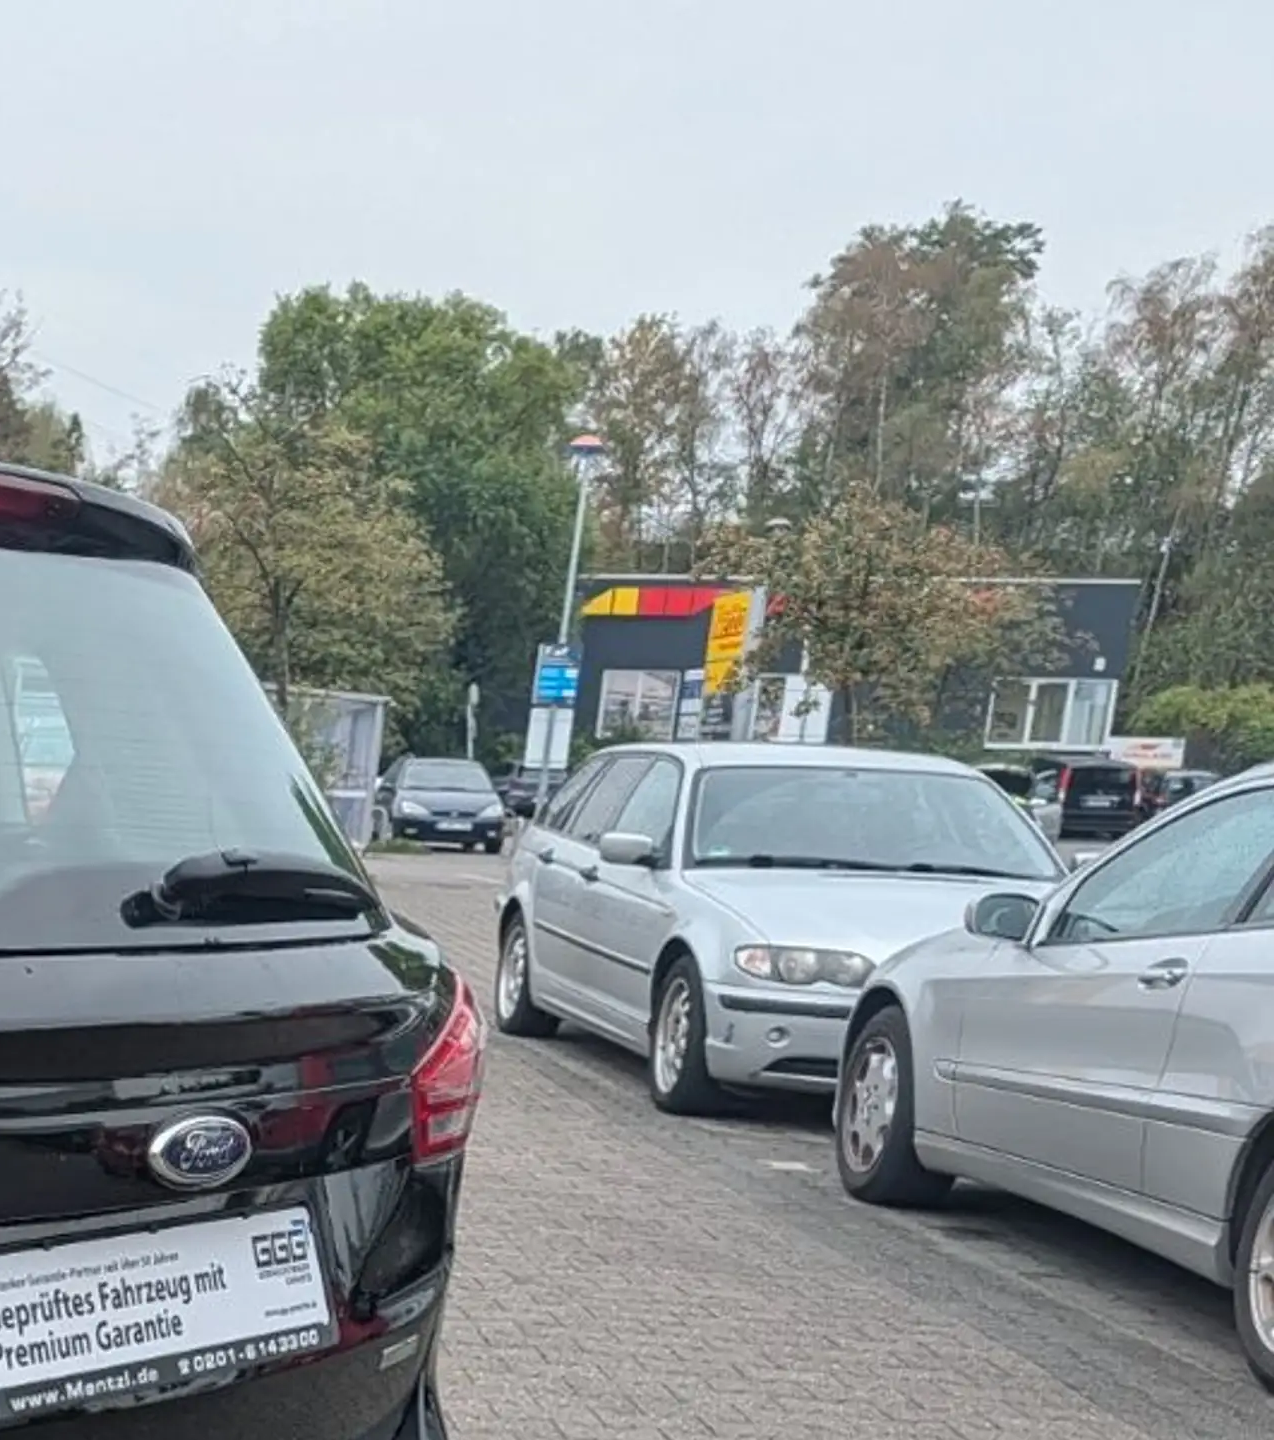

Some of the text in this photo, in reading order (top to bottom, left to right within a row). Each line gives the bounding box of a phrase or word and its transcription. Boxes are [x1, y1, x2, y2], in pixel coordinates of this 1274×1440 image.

[180, 1130, 235, 1170] Ford
[251, 1228, 309, 1268] GGG
[97, 1276, 193, 1312] Fahrzeug
[194, 1262, 227, 1294] mit
[95, 1308, 184, 1351] Garantie
